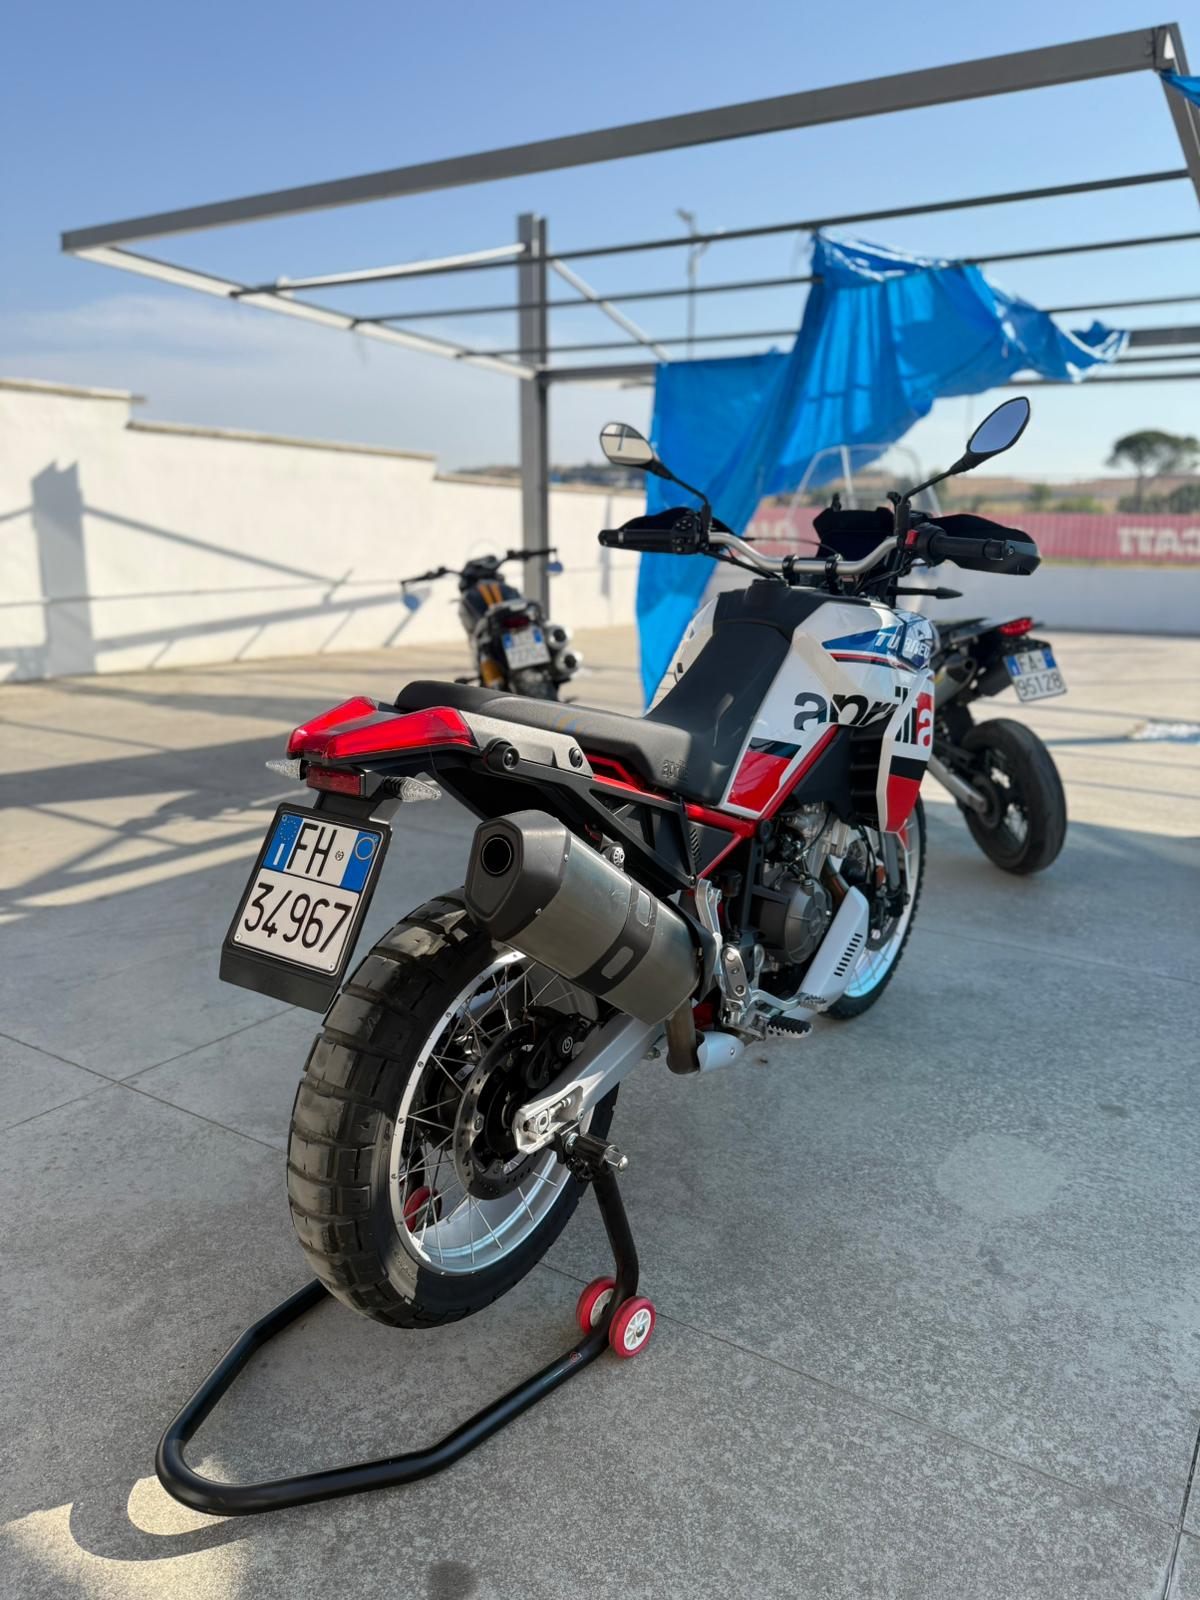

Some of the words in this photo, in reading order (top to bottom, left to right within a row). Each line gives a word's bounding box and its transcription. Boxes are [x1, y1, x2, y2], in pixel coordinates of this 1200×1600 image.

[1016, 671, 1062, 697] 95128
[1018, 655, 1039, 674] FA
[287, 822, 338, 877] FH
[244, 883, 353, 953] 34967
